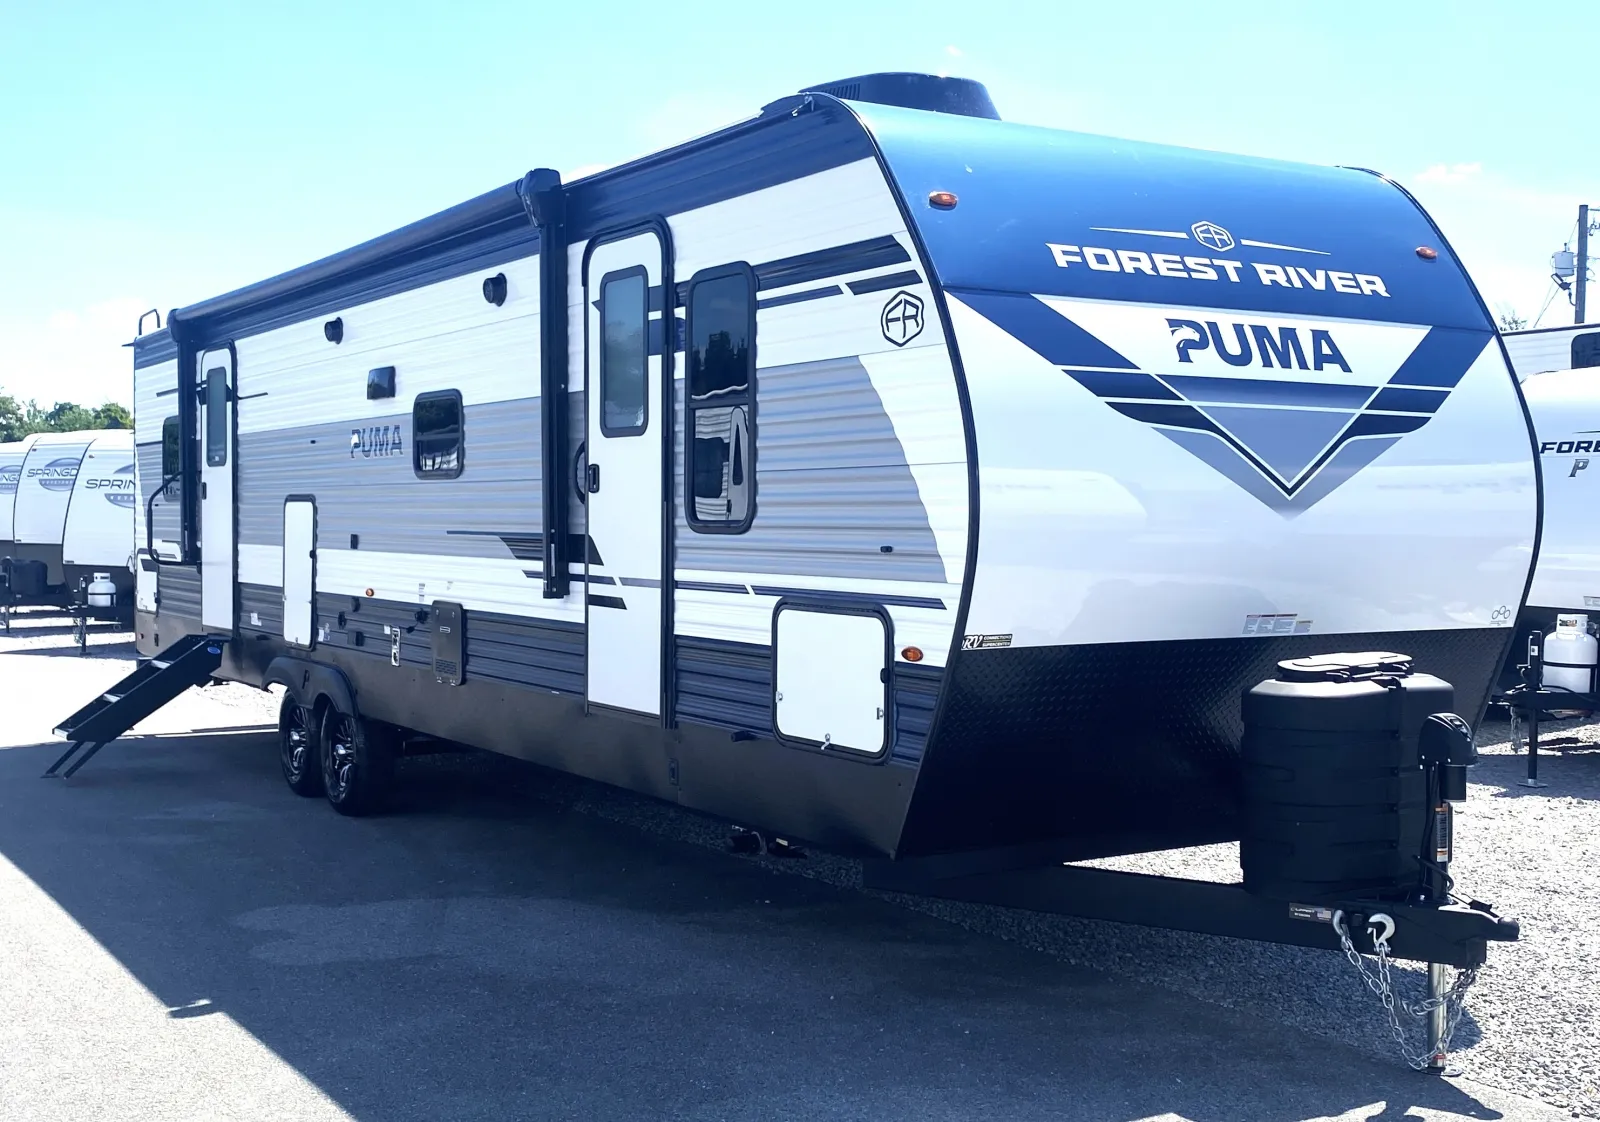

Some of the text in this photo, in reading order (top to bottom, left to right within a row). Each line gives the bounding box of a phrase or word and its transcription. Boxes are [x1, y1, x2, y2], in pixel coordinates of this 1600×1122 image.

[1045, 242, 1392, 298] FOREST RIVER
[1164, 318, 1353, 373] PUMA
[350, 424, 404, 459] PUMA
[962, 634, 983, 649] RV
